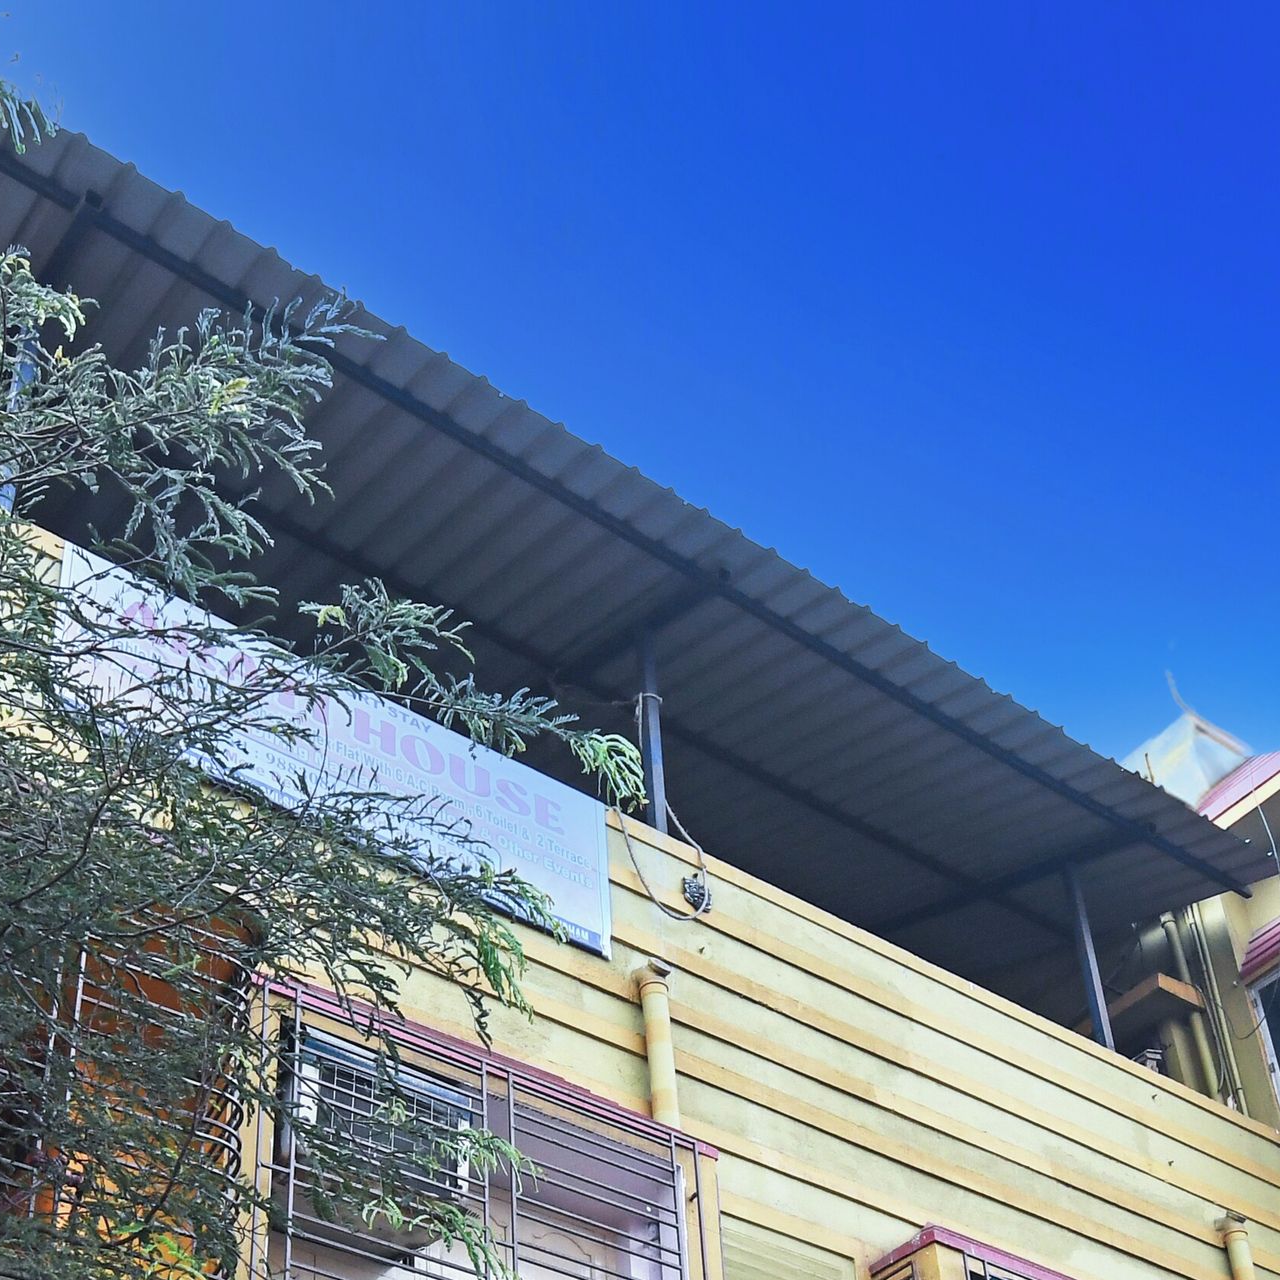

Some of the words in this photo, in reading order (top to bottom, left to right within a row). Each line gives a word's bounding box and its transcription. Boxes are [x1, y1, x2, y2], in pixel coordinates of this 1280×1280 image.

[353, 705, 565, 838] HOUSE
[388, 704, 432, 737] STAY
[335, 737, 360, 763] Flat
[485, 807, 518, 836] Toilet
[535, 831, 544, 849] 2
